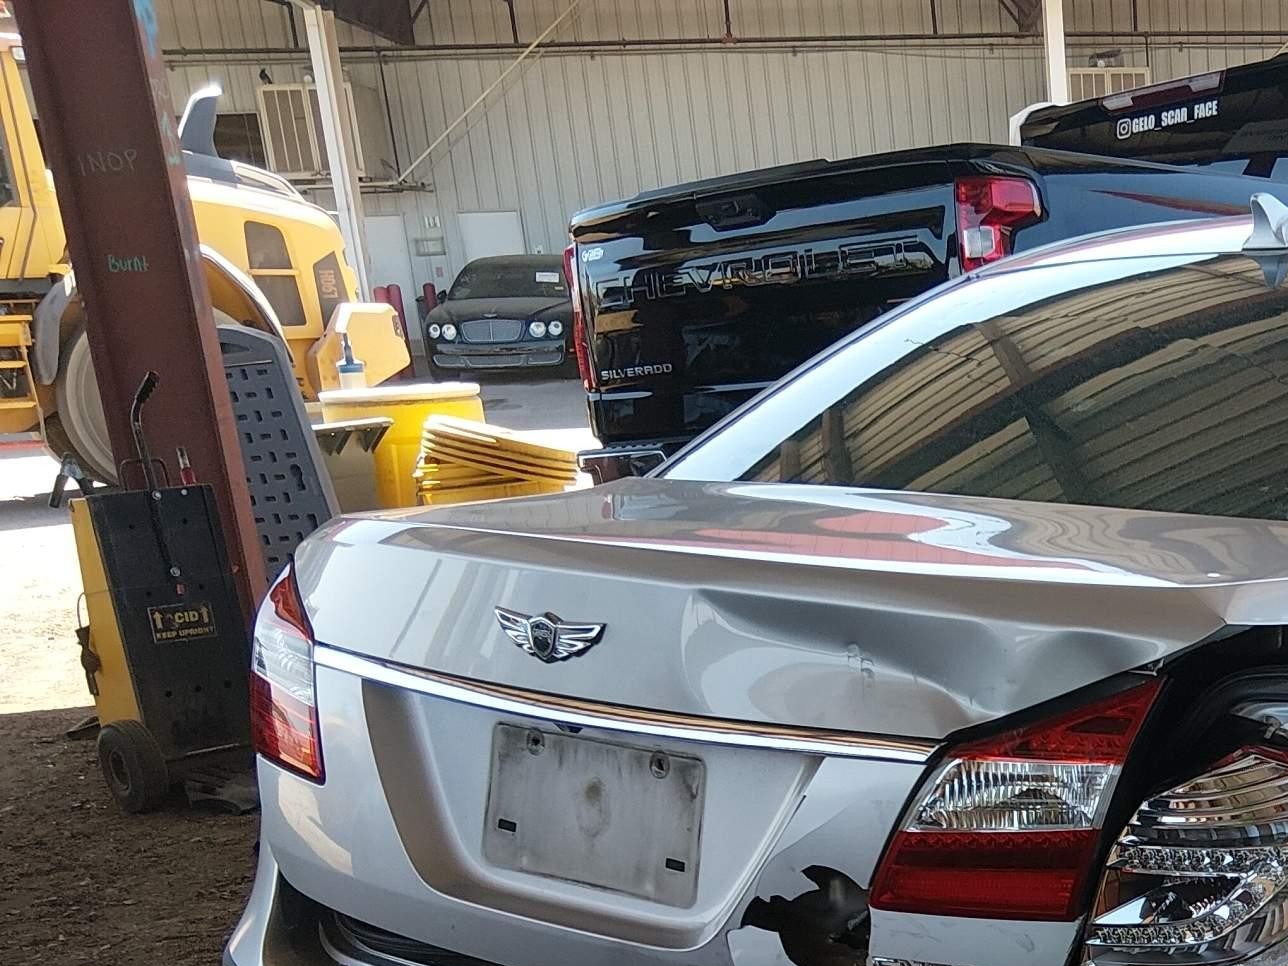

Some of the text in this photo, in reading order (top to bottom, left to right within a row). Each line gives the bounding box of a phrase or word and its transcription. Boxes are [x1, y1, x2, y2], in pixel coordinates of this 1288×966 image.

[79, 148, 137, 176] INOP
[107, 255, 149, 272] Burnt
[596, 236, 919, 308] CHEVROLET
[600, 362, 674, 382] SILVERADO
